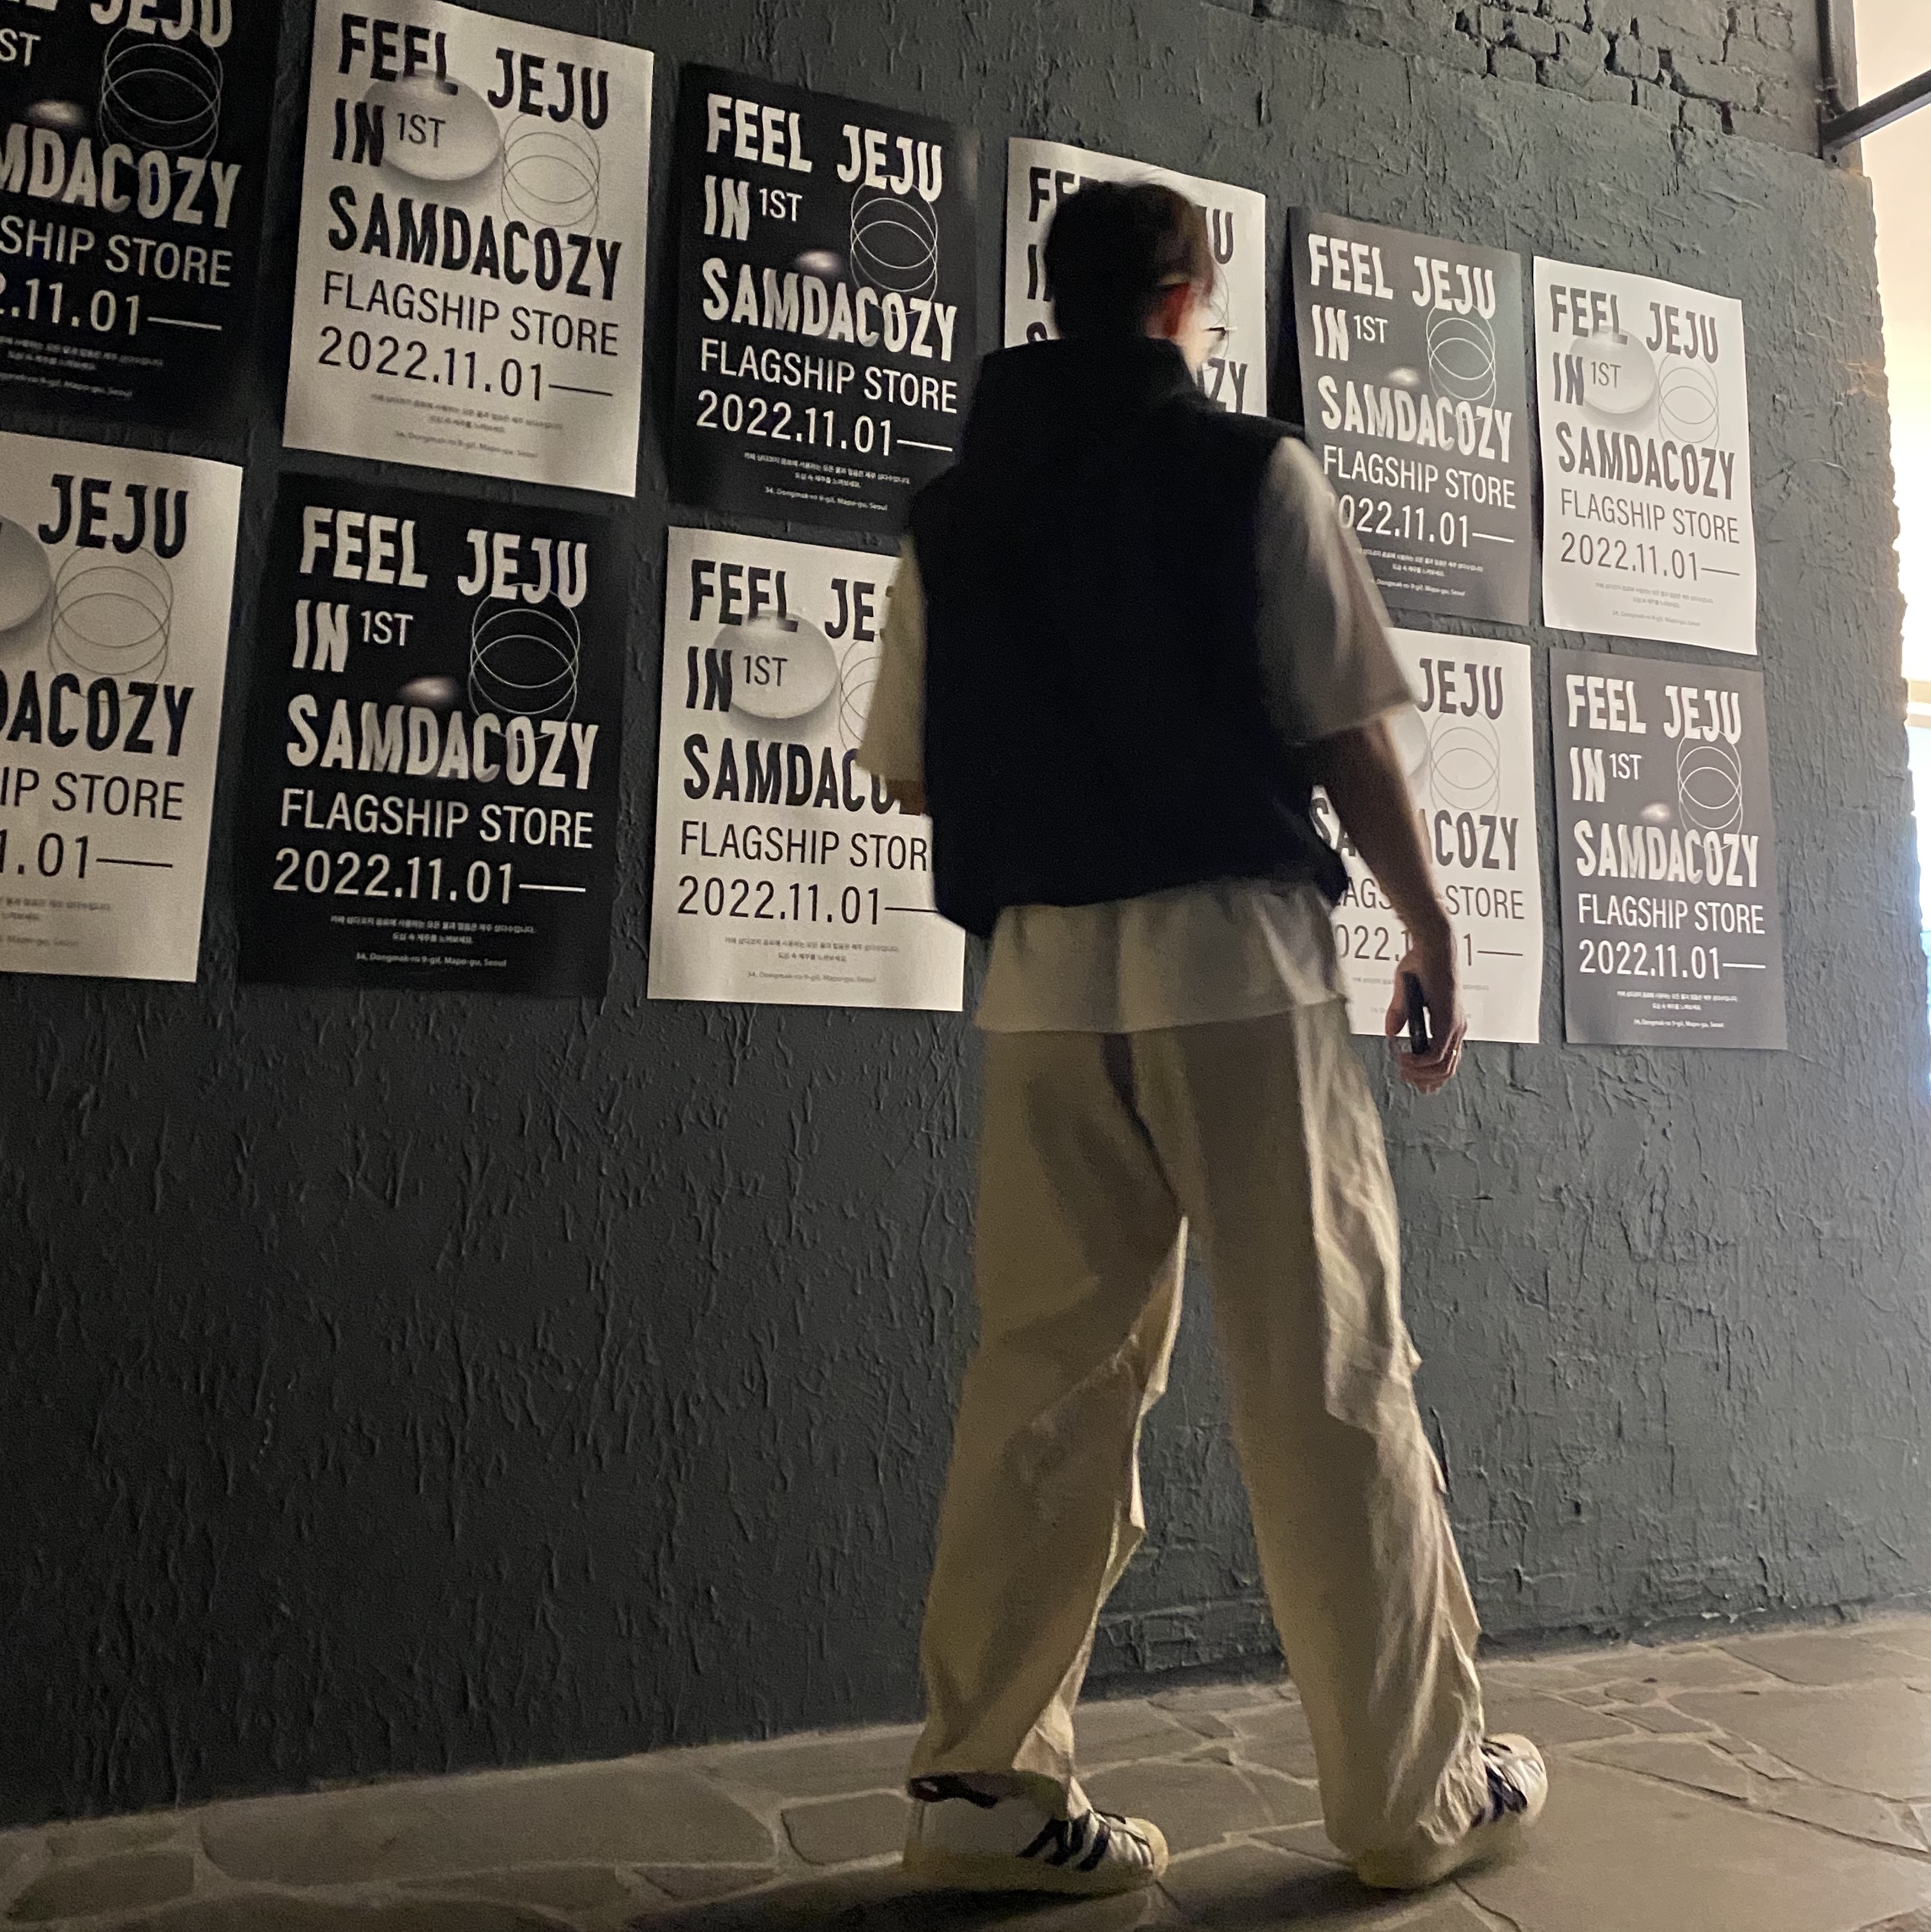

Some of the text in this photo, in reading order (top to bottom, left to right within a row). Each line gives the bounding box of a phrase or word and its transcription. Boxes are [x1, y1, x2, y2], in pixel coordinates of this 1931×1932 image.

[0, 28, 41, 66] ST
[339, 13, 609, 130] FEEL JEJU
[332, 98, 446, 167] IN 1ST
[706, 93, 812, 173] FEEL
[837, 124, 943, 202] JEJU
[0, 123, 242, 228] MDACOZY
[703, 174, 803, 241] IN 1ST
[0, 215, 233, 287] SHIP STORE
[328, 185, 622, 301] SAMDACOZY
[1308, 233, 1393, 300] FEEL
[1412, 255, 1495, 319] JEJU
[323, 270, 618, 356] FLAGSHIP STORE
[702, 257, 958, 362] SAMDACOZY
[1312, 305, 1387, 361] IN 1ST
[1550, 284, 1719, 365] FEEL JEJU
[701, 338, 958, 414] FLAGSHIP STORE
[1553, 353, 1621, 406] IN 1ST
[1318, 375, 1513, 463] SAMDACOZY
[1323, 445, 1516, 510] FLAGSHIP STORE
[1555, 422, 1735, 501] SAMDACOZY
[38, 474, 188, 559] JEJU
[1329, 491, 1467, 547] 022.11.01
[1561, 489, 1741, 544] FLAGSHIP STORE
[300, 506, 588, 608] FEEL JEJU
[292, 599, 413, 672] IN 1ST
[689, 559, 894, 643] FEEL JE
[0, 669, 194, 756] ACOZY
[685, 646, 788, 712] IN 1ST
[1417, 658, 1503, 720] JEJU
[1566, 674, 1741, 744] FEEL JEJU
[286, 694, 599, 789] SAMDACOZY
[1569, 747, 1641, 802] IN 1ST
[52, 772, 184, 820] STORE
[280, 788, 593, 848] FLAGSHIP STORE
[680, 821, 927, 871] FLAGSHIP STOR
[1573, 820, 1759, 888] SAMDACOZY
[1446, 885, 1524, 919] STORE
[1578, 894, 1765, 934] FLAGSHIP STORE
